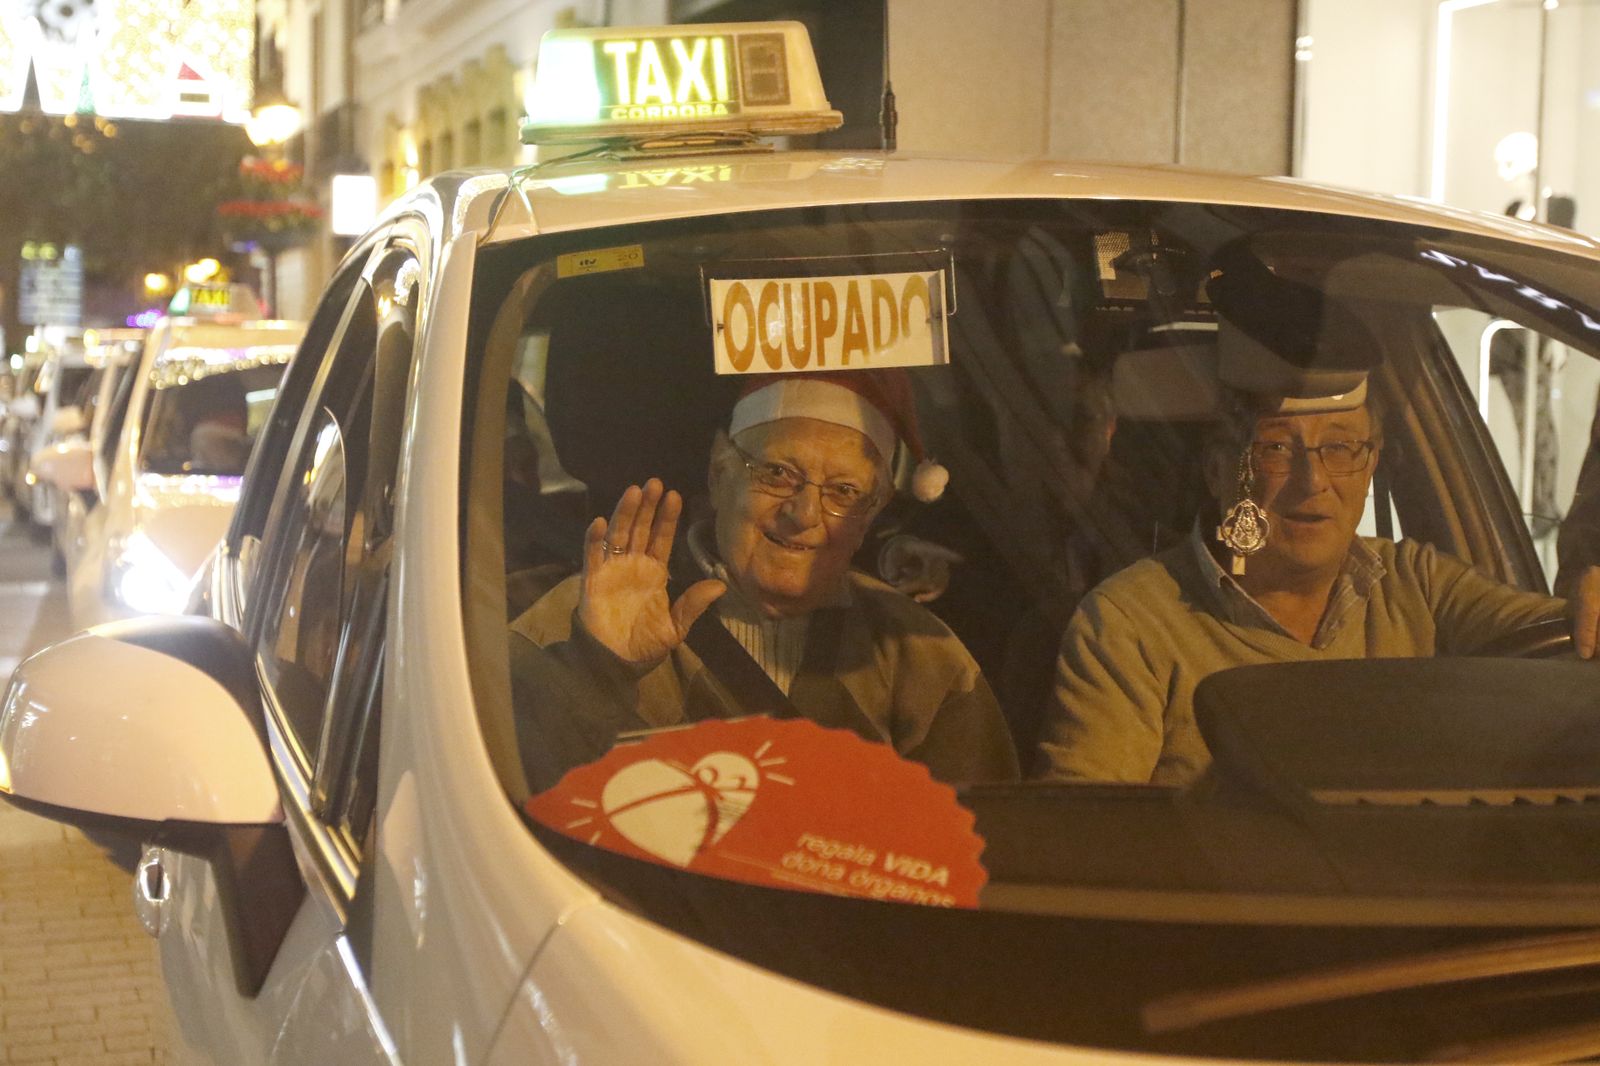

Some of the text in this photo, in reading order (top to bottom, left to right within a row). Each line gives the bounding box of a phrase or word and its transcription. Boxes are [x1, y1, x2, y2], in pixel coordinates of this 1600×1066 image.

[604, 38, 727, 104] TAXI
[611, 105, 728, 118] CORDOBA
[782, 850, 844, 880] dona
[798, 834, 949, 887] regala VIDA
